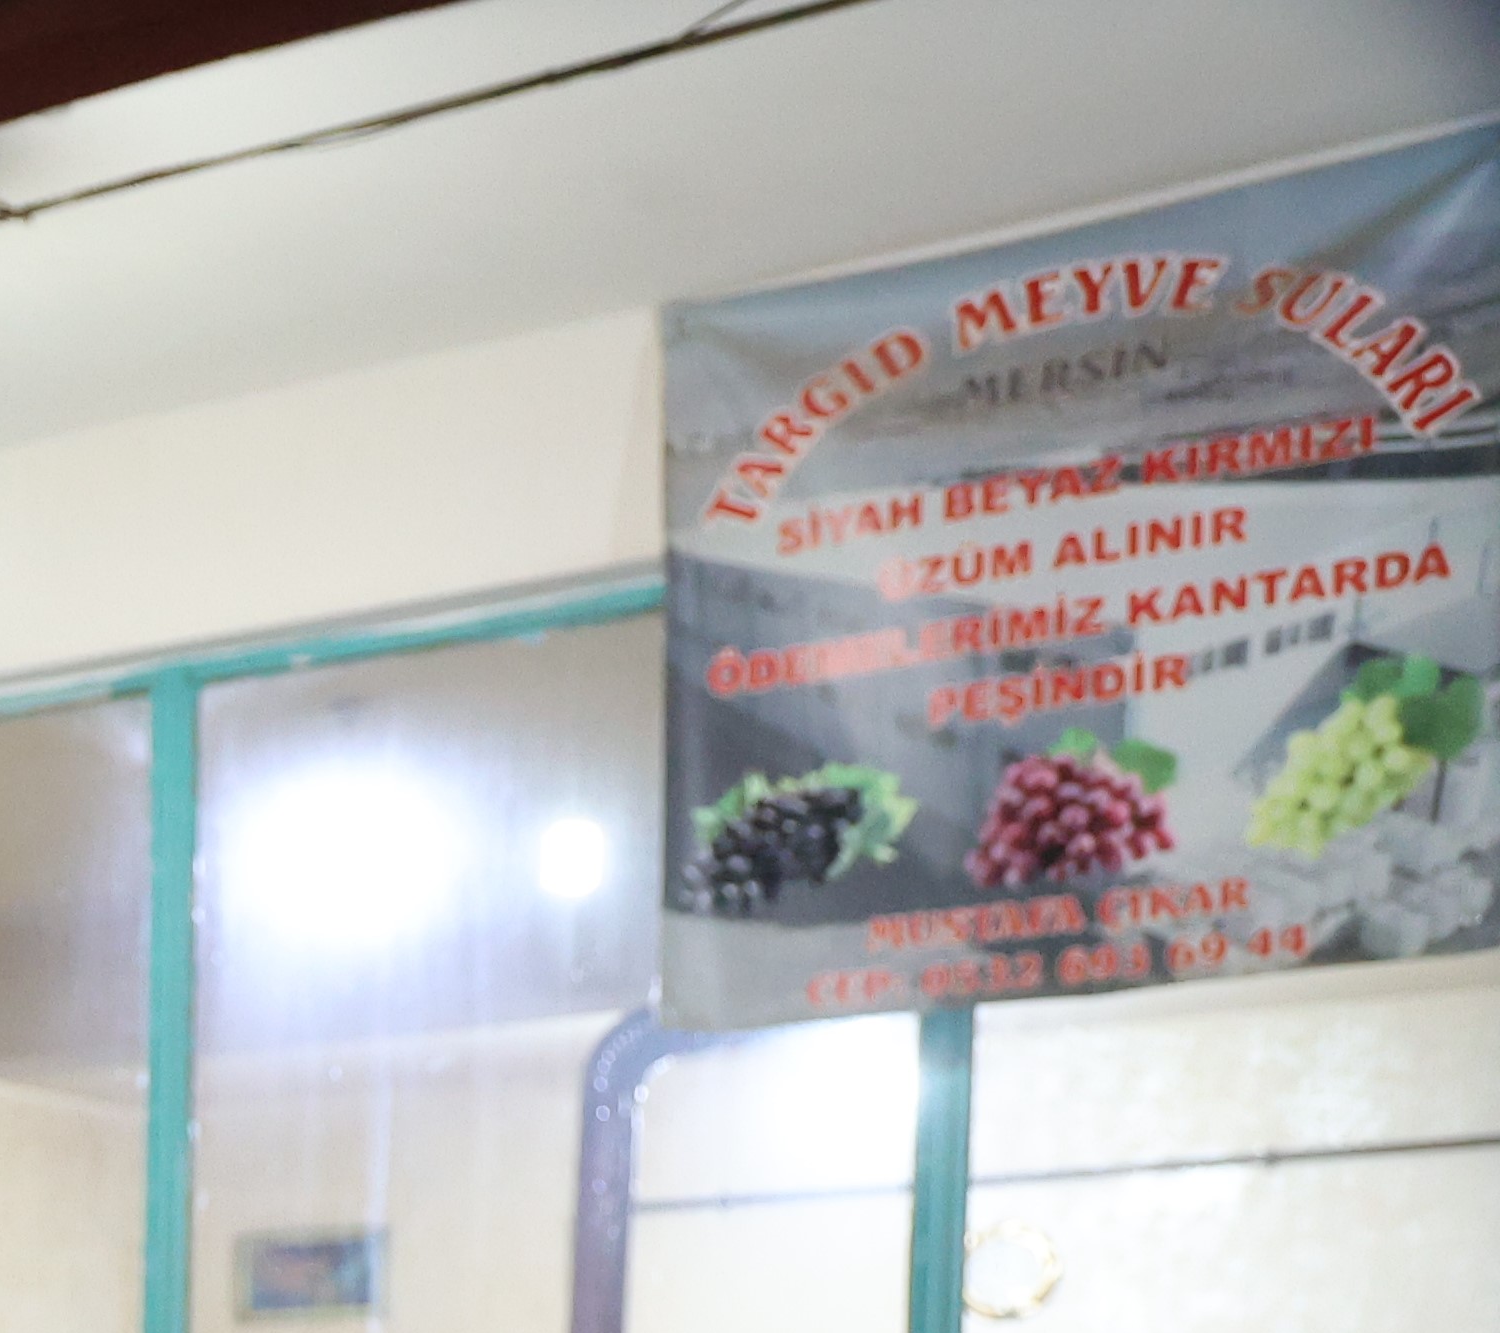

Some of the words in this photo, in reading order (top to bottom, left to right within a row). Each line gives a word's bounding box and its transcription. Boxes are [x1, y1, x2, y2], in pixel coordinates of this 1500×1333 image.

[953, 255, 1224, 356] MEYVE
[1233, 262, 1478, 434] SULARI
[943, 452, 1125, 522] BEYAZ
[1140, 413, 1379, 485] KIRMIZI
[1052, 505, 1249, 574] ALINIR
[1126, 540, 1452, 628] KANTARDA
